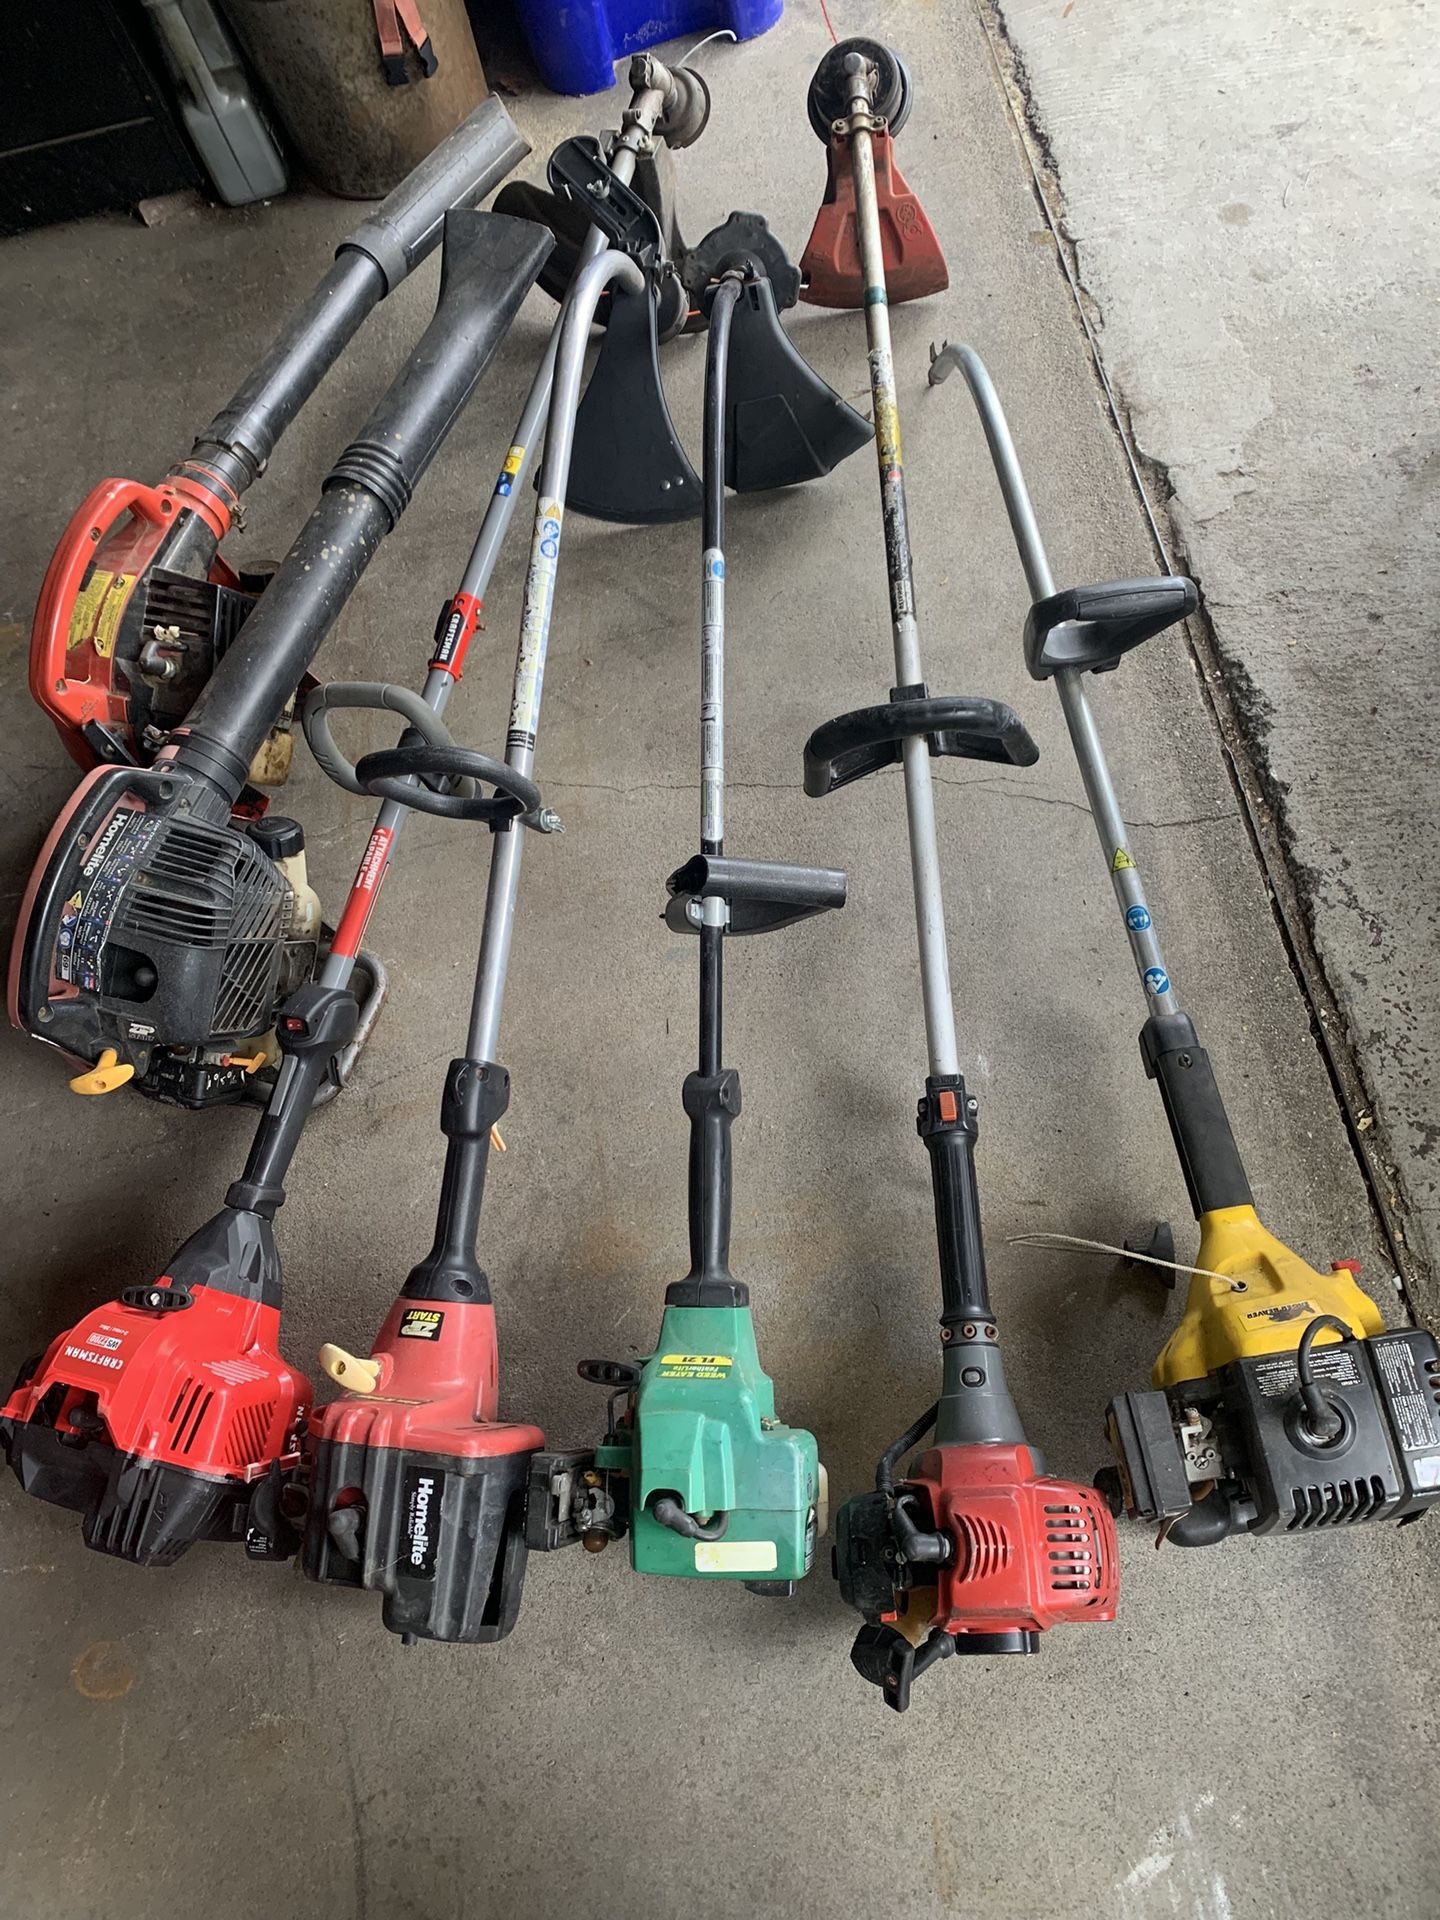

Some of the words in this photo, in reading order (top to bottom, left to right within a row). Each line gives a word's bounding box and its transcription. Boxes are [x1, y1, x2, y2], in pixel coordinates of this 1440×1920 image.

[438, 612, 461, 662] CRAFTSMAN
[82, 812, 129, 878] Homelite
[358, 834, 379, 874] CAPABLE
[363, 835, 387, 891] ATTACHMENT
[406, 1310, 441, 1323] START
[64, 1345, 124, 1370] CRAFTSMAN
[660, 1370, 695, 1378] EATER
[696, 1371, 726, 1379] WEED
[408, 1490, 417, 1511] Simply
[410, 1477, 434, 1566] Homelite
